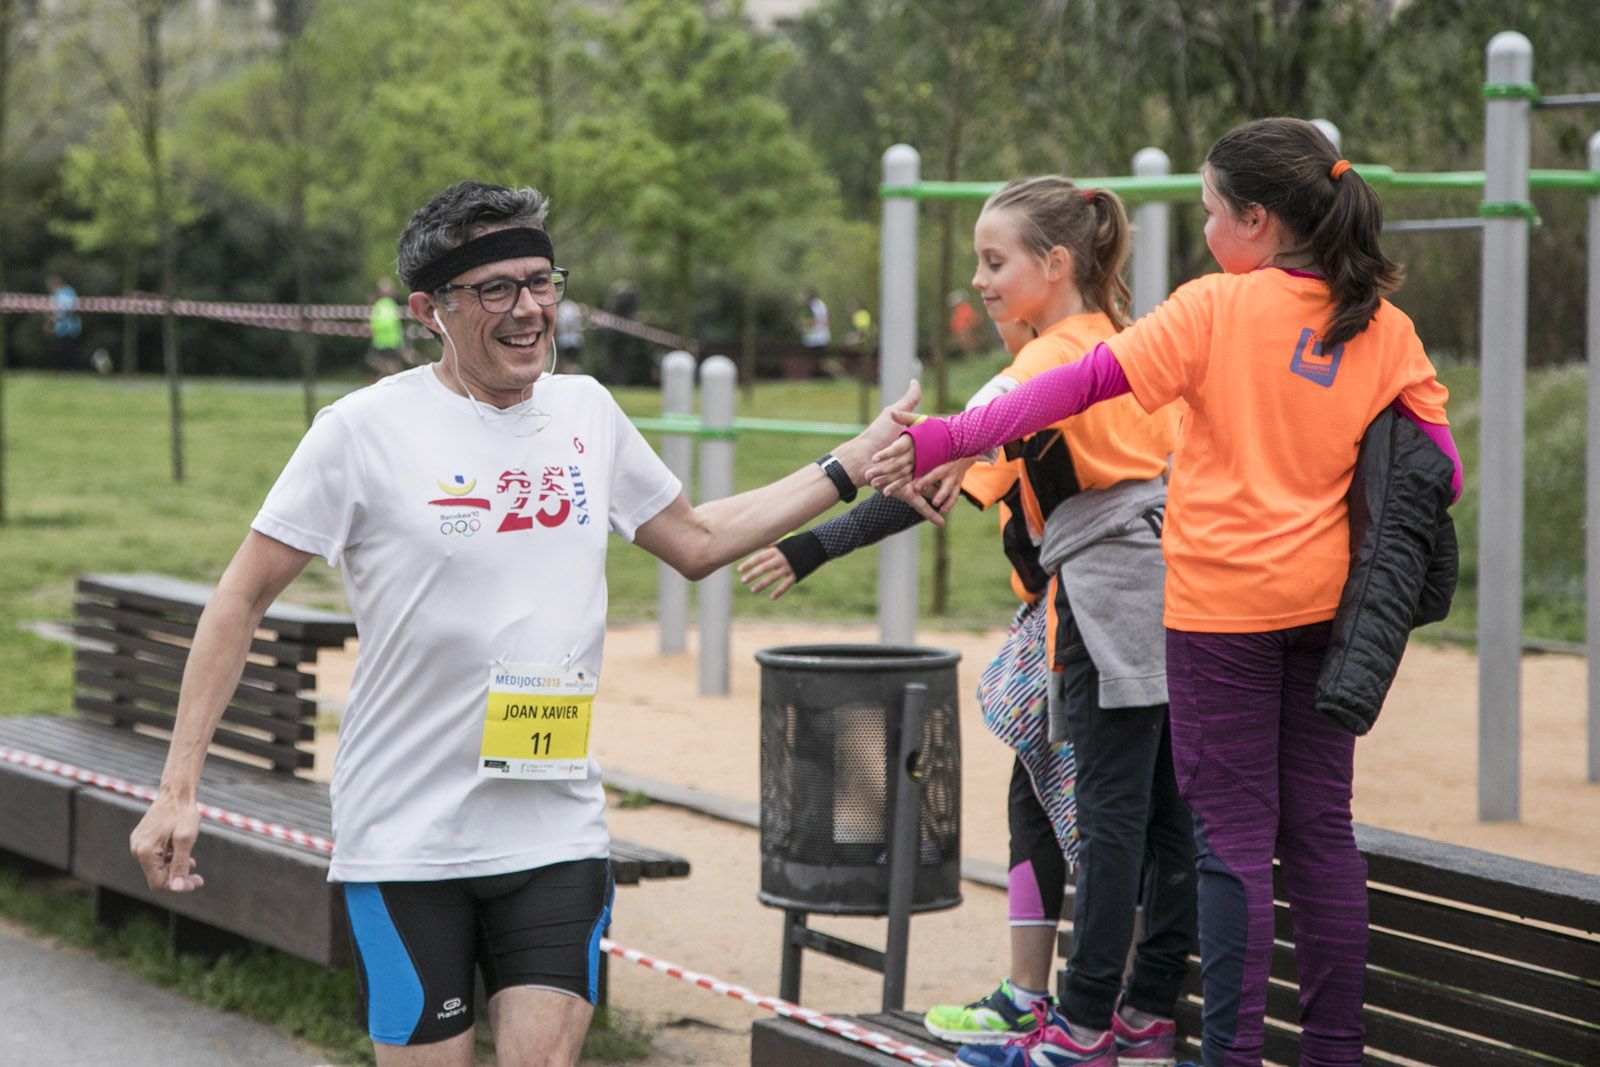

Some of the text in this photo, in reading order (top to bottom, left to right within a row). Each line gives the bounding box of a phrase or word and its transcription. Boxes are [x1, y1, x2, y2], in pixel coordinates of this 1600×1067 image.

[496, 467, 571, 532] 25
[568, 466, 590, 525] anys
[503, 704, 578, 721] JOAN XAVIER
[531, 732, 552, 755] 11
